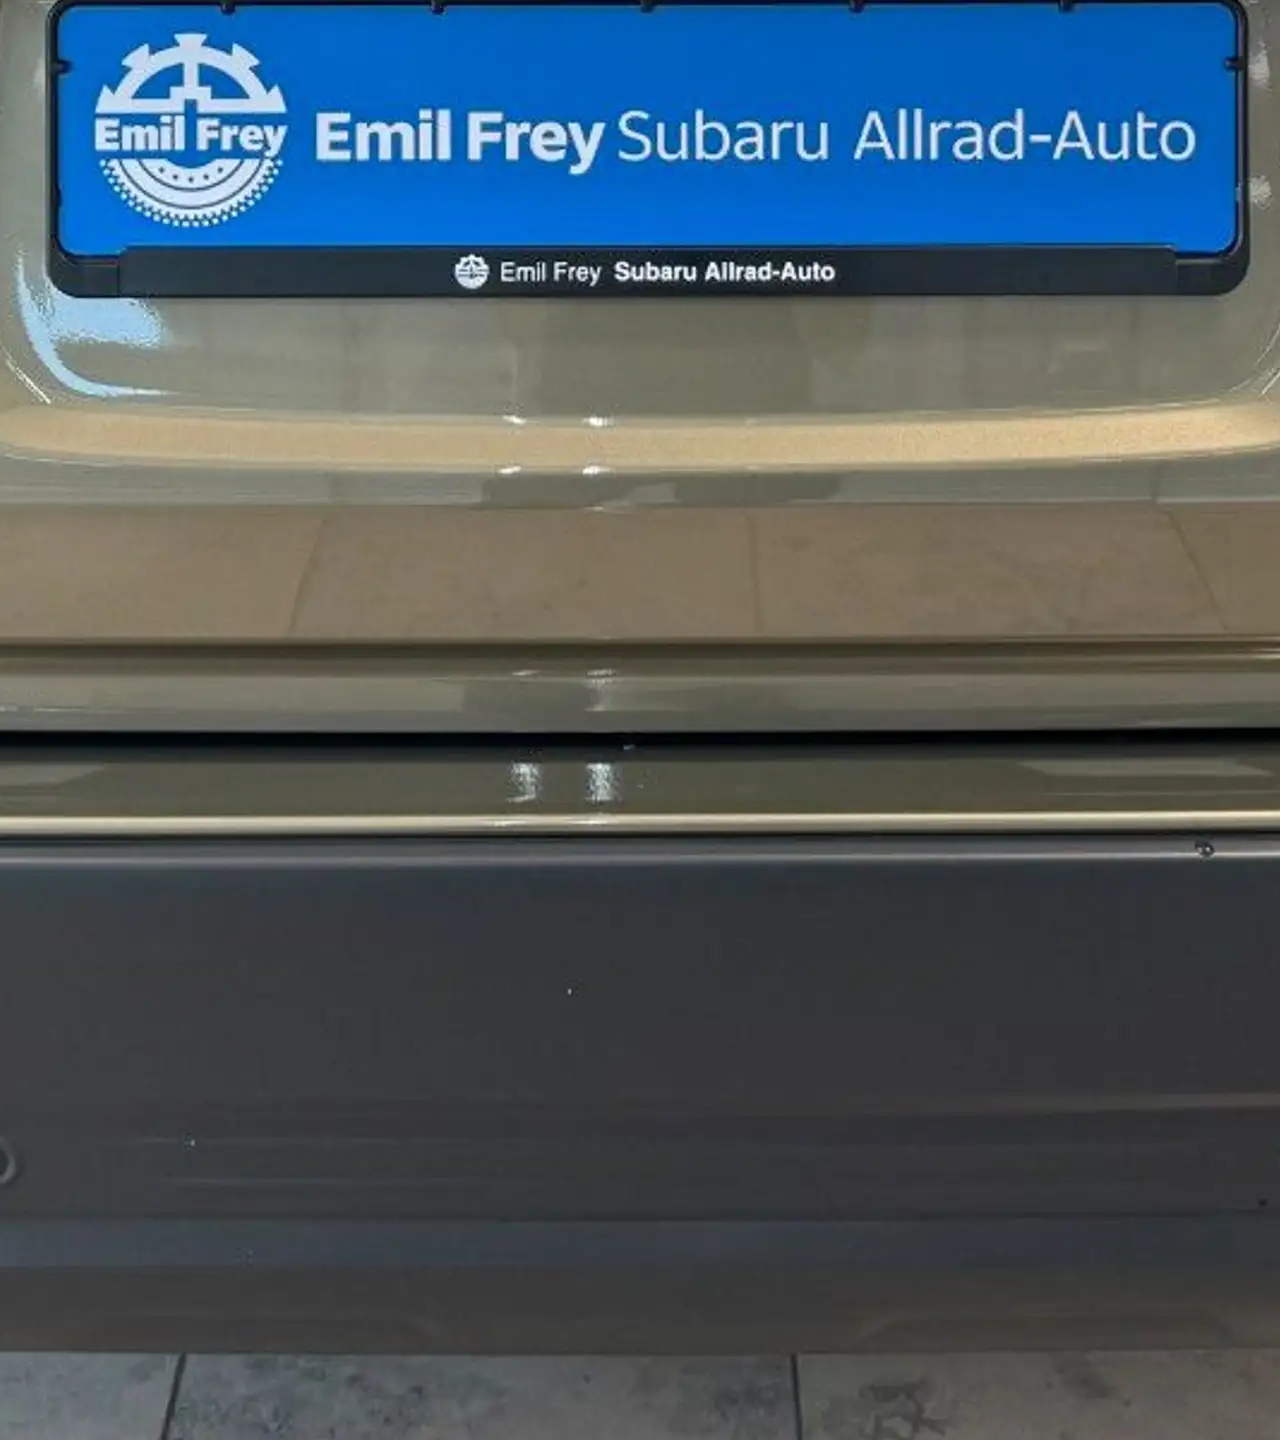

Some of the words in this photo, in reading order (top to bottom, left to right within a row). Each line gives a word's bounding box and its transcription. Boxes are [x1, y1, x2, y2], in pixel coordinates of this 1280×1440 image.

[94, 114, 186, 151] Emil
[195, 117, 288, 161] Frey
[315, 109, 453, 162] Emil
[467, 111, 606, 176] Frey
[618, 109, 830, 161] Subaru
[852, 108, 1198, 161] Allrad-Auto
[500, 261, 547, 283] Emil
[553, 261, 602, 287] Frey
[614, 261, 697, 282] Subaru
[704, 261, 836, 282] Allrad-Auto
